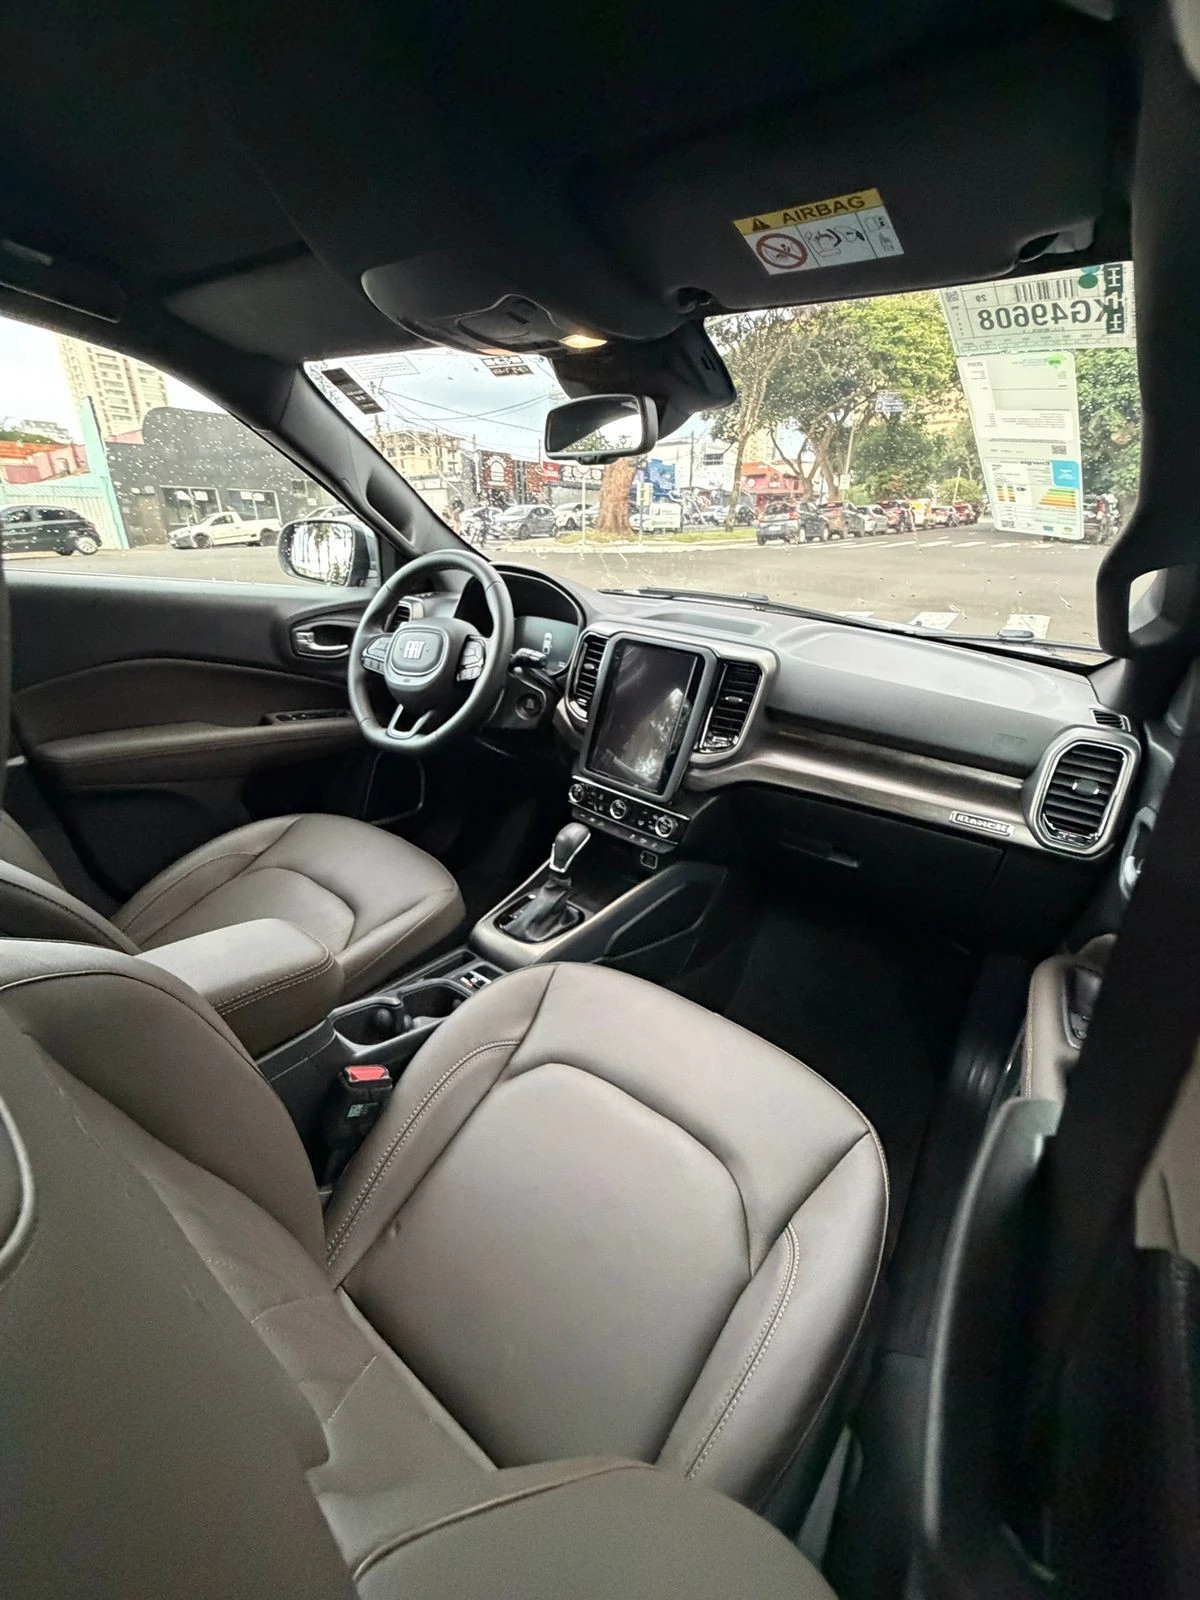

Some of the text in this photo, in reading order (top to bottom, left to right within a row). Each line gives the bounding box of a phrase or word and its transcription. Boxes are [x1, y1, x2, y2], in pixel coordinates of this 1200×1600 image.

[782, 196, 866, 224] AIRBAG
[404, 640, 426, 659] FIAT
[956, 813, 1008, 832] RANCH
